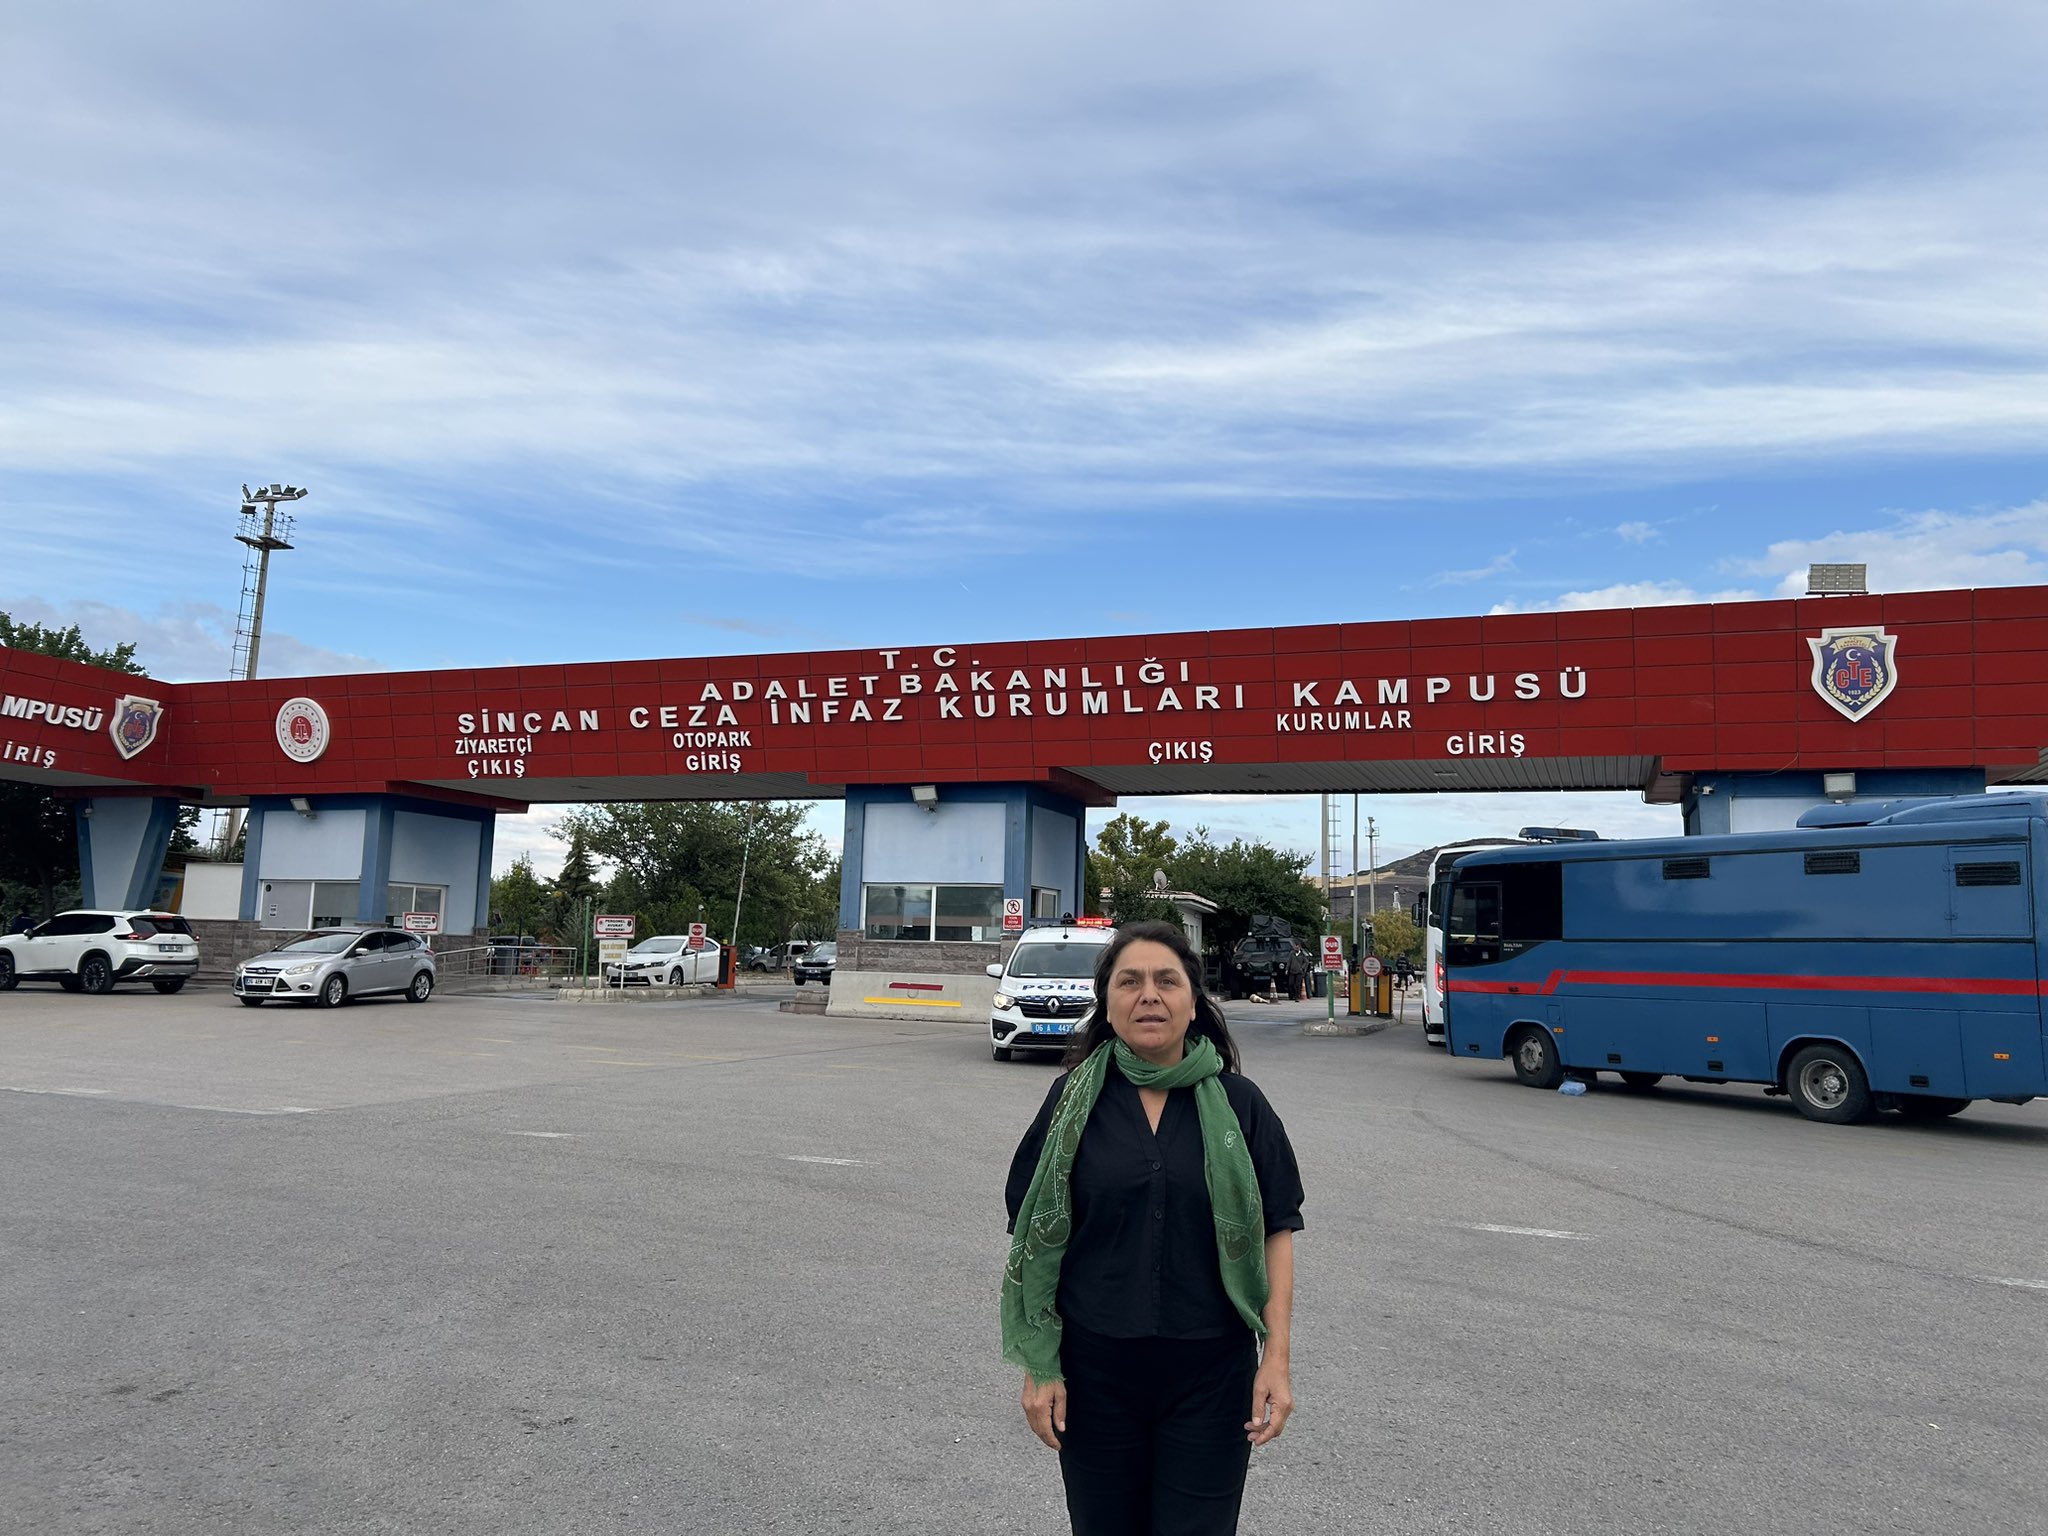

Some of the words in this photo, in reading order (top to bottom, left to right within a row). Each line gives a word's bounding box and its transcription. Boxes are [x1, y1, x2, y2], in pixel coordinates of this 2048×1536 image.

[879, 648, 980, 670] T.C.
[701, 675, 880, 703] ADALET
[899, 656, 1189, 694] BAKANLIĞI
[457, 708, 599, 734] SİNCAN
[630, 704, 739, 729] CEZA
[770, 698, 903, 725] İNFAZ
[940, 684, 1244, 719] KURUMLARI
[1293, 666, 1586, 707] KAMPUSÜ
[0, 695, 103, 731] MPUSÜ
[1277, 710, 1412, 732] KURUMLAR
[454, 735, 533, 757] ZİYARETÇİ
[673, 731, 752, 749] OTOPARK
[1446, 731, 1525, 758] GİRİŞ
[686, 751, 742, 774] GİRİŞ
[1148, 741, 1213, 765] ÇIKIŞ
[467, 758, 525, 779] ÇIKIŞ
[1035, 1024, 1044, 1032] 06
[1046, 1024, 1051, 1032] A
